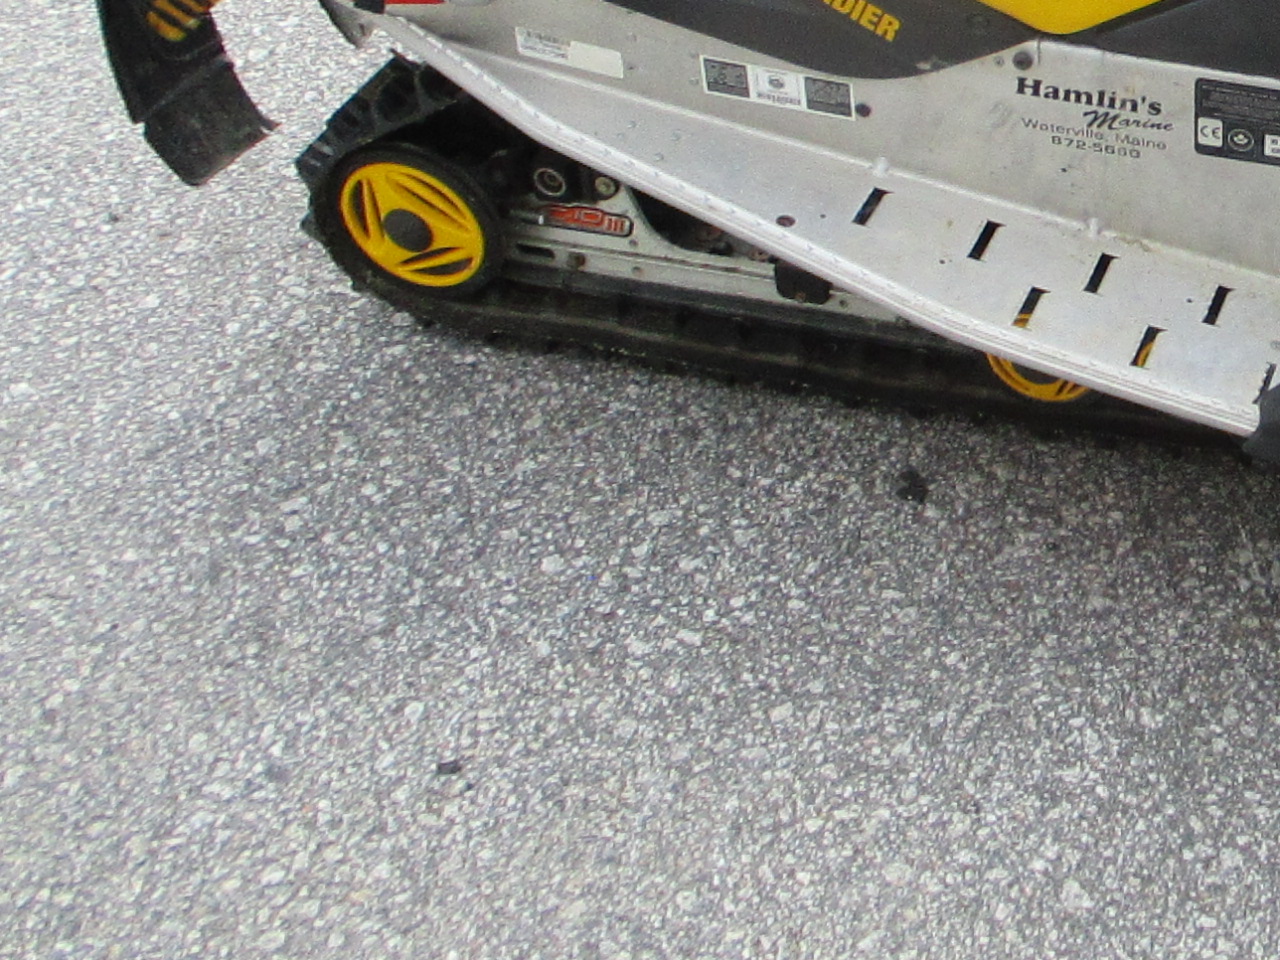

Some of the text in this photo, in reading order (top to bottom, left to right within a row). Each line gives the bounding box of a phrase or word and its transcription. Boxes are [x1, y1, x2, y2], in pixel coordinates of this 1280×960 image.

[1016, 77, 1162, 116] Hamlin's
[1082, 110, 1175, 131] Marine
[1115, 134, 1167, 151] Maine
